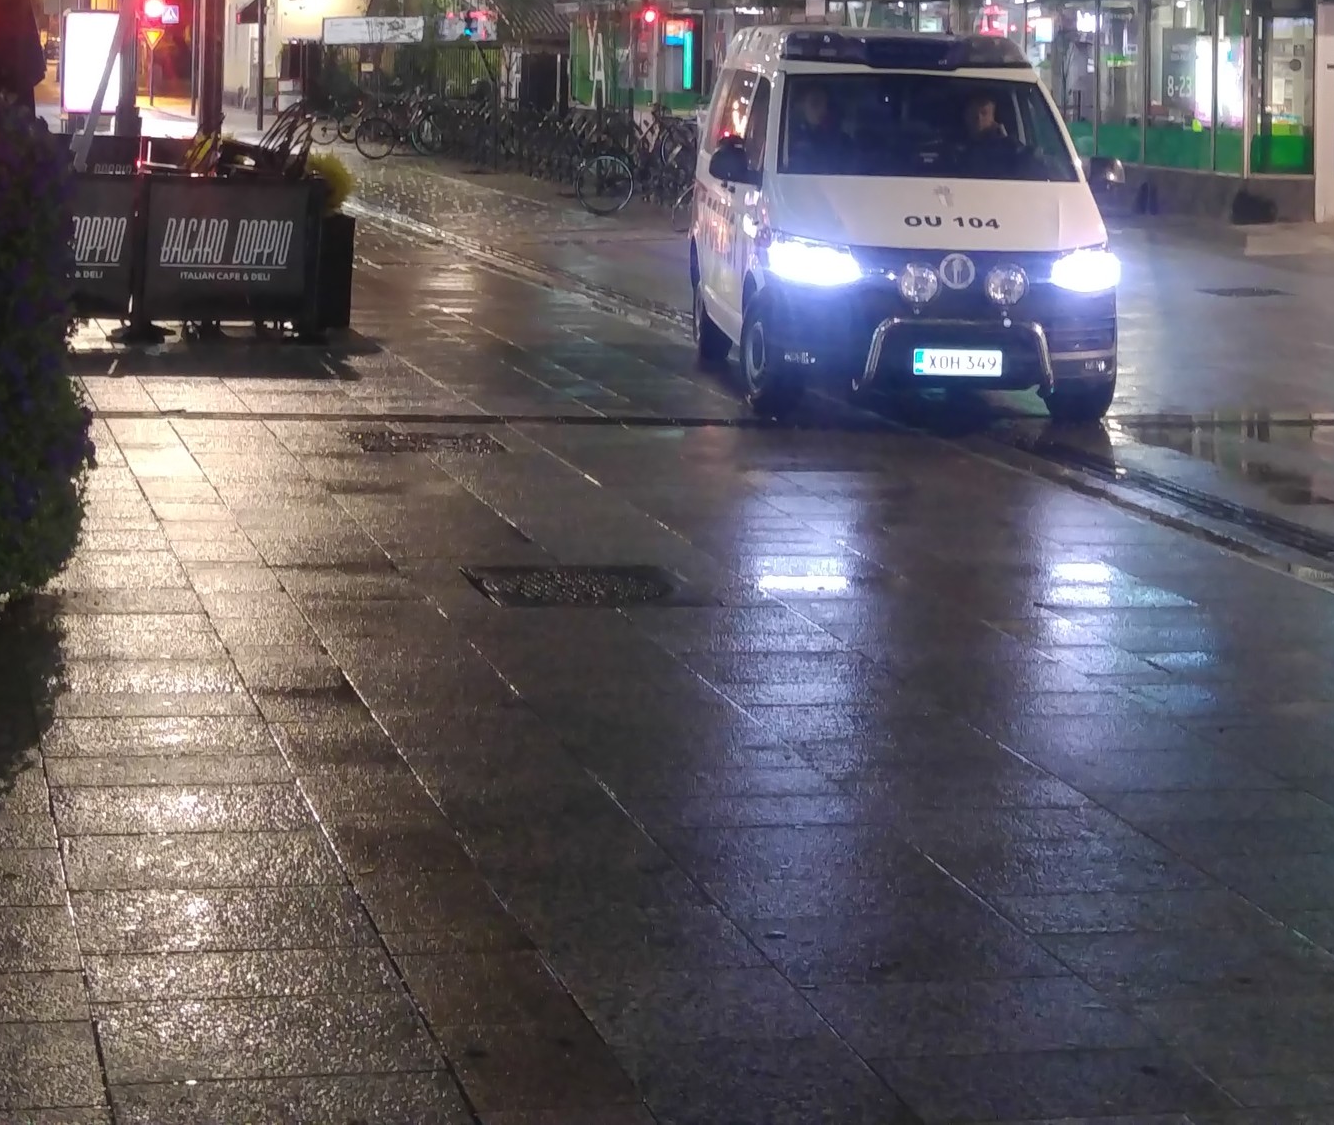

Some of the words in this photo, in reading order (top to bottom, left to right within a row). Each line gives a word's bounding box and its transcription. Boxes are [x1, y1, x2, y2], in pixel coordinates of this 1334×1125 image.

[1167, 76, 1193, 98] 8-23
[904, 215, 942, 227] OU
[953, 217, 1000, 229] 104
[160, 218, 228, 265] BACARO
[232, 219, 294, 266] DOPPIO
[83, 270, 103, 279] DELI
[180, 271, 216, 281] ITALIAN
[216, 272, 240, 281] CAFE
[251, 273, 271, 282] DELI
[966, 356, 997, 370] 349
